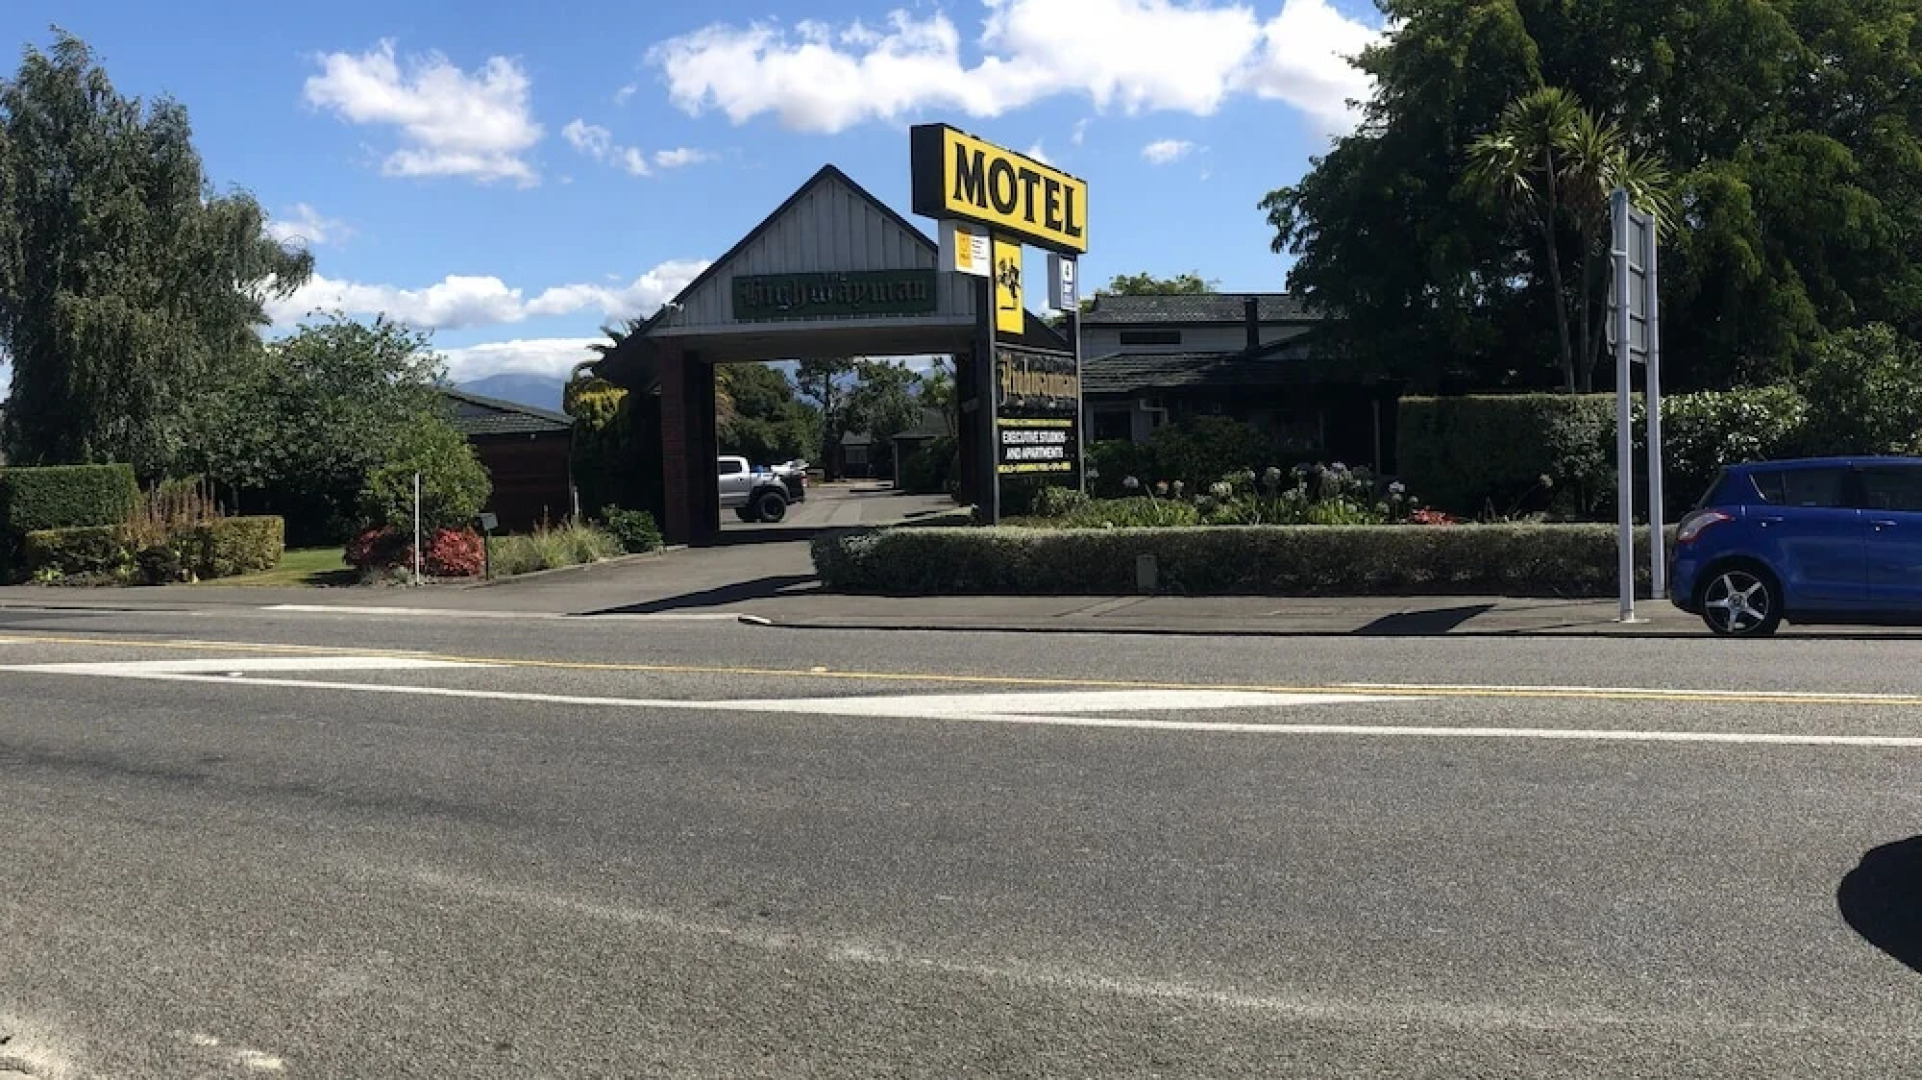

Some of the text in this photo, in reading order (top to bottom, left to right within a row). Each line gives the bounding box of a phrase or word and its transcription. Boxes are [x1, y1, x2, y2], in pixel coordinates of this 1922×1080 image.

[953, 141, 1083, 238] MOTEL
[1002, 430, 1038, 444] EXECUTIVE
[1005, 446, 1064, 460] AND APARTMENTS
